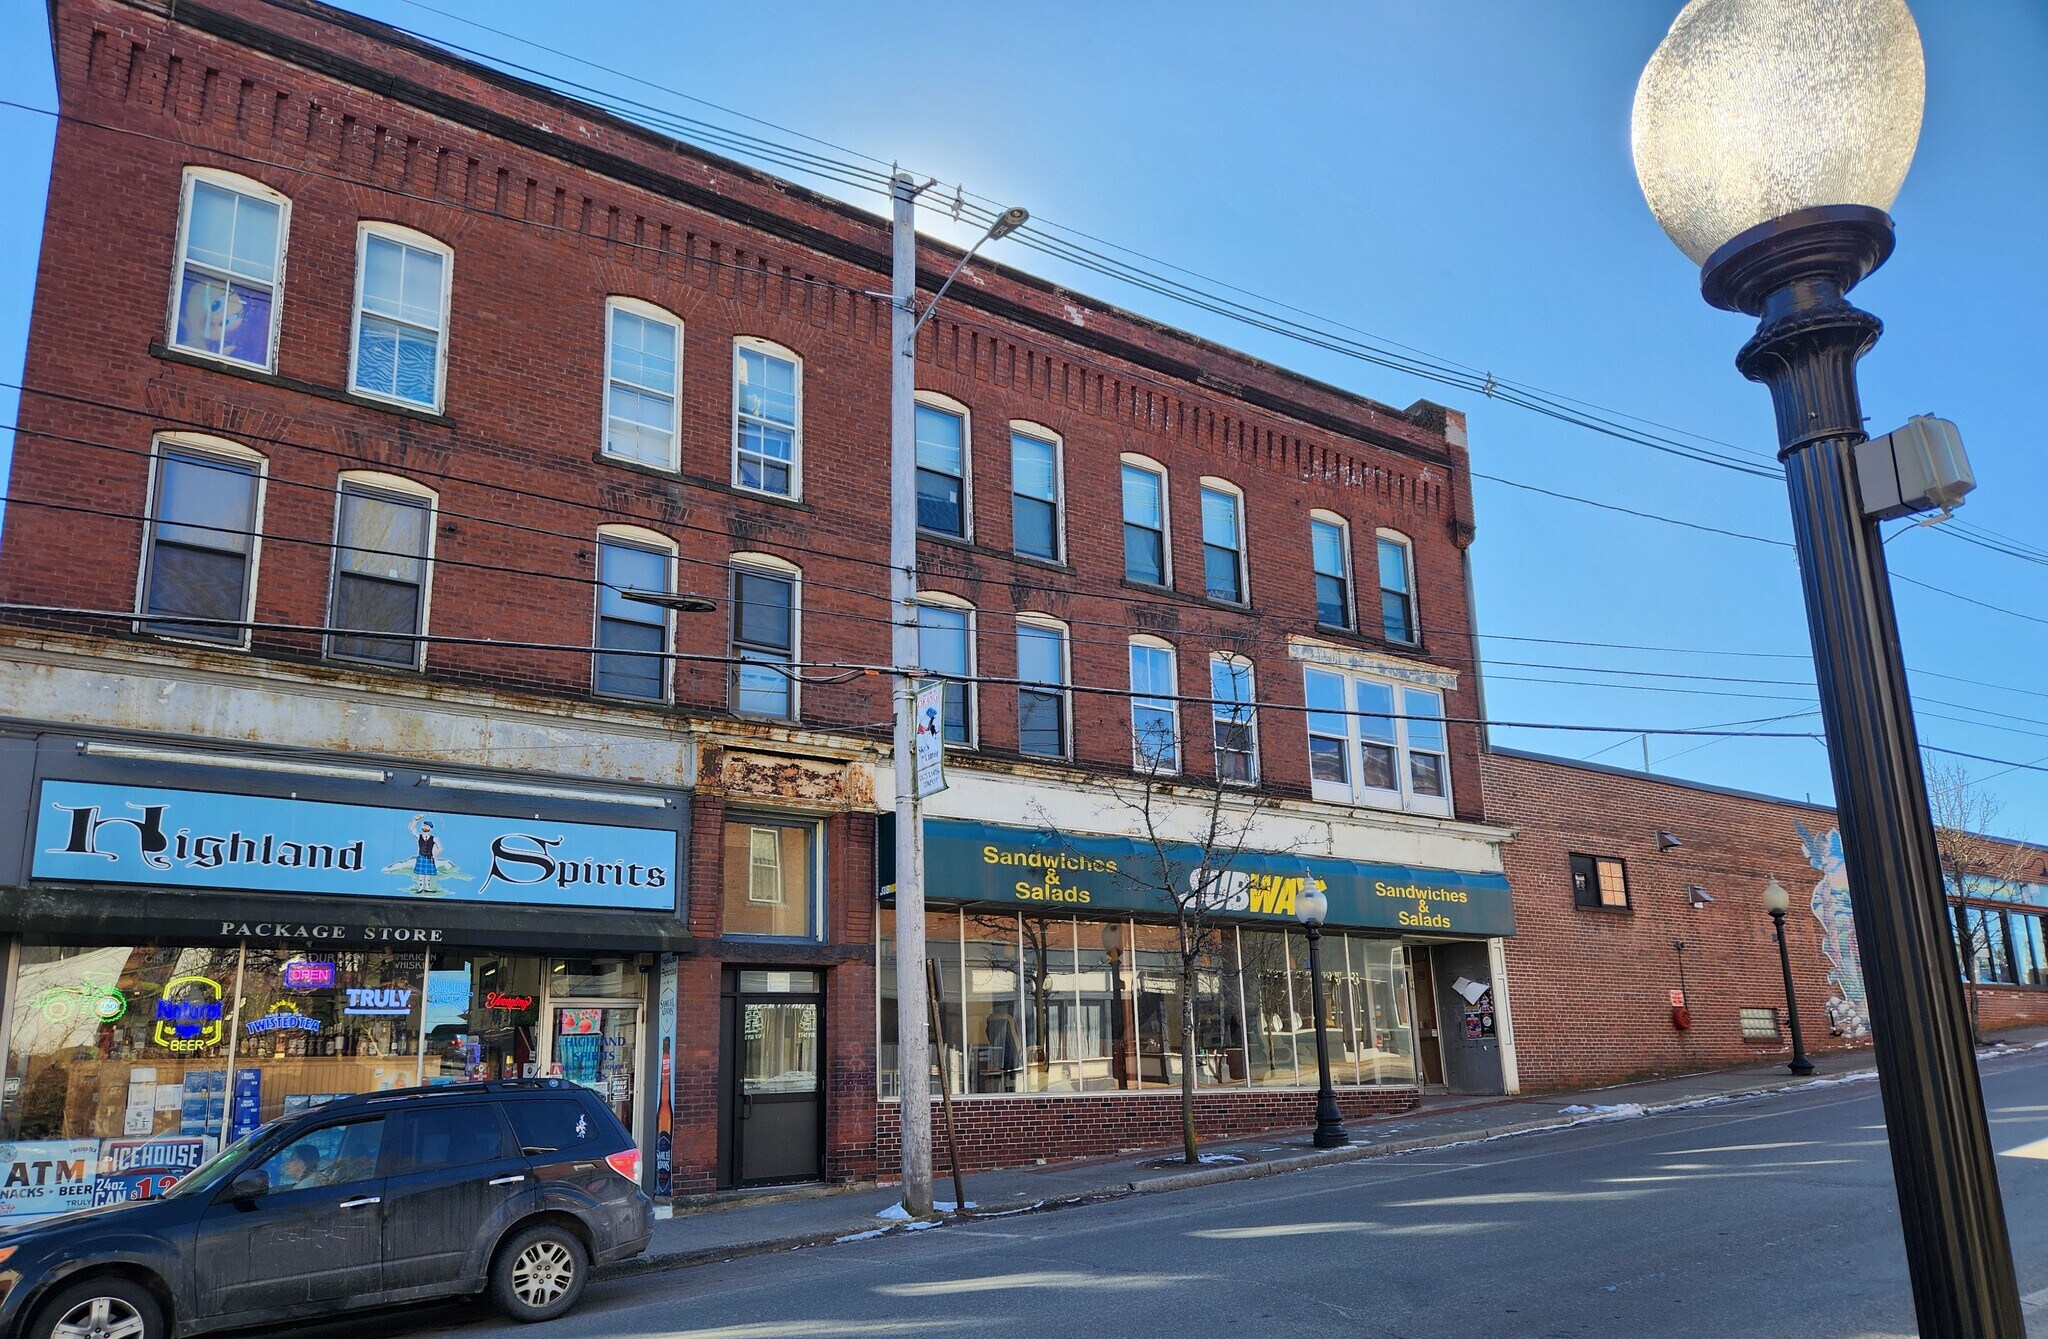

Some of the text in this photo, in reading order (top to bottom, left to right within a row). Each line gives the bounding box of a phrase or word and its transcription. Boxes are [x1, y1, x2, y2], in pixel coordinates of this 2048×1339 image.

[45, 801, 366, 872] Highland
[477, 832, 669, 895] Spirits
[983, 846, 1118, 873] Sandwiches
[1045, 868, 1061, 885] &
[1015, 881, 1091, 903] Salads
[1375, 881, 1468, 904] Sandwiches
[1418, 899, 1430, 914] &
[1398, 910, 1451, 929] Salads
[220, 921, 443, 943] PACKAGE STORE
[394, 953, 437, 962] MERICN
[290, 968, 330, 981] OPEN
[246, 1016, 321, 1034] TWISTED TEA
[170, 1039, 205, 1051] BEER
[573, 1050, 615, 1062] SPIRTS
[113, 1143, 200, 1171] ICEHOUSE
[4, 1159, 86, 1188] ATM
[0, 1185, 93, 1200] NACKS BEER
[96, 1178, 128, 1192] 24oz.
[66, 1199, 92, 1207] TRULY
[94, 1190, 127, 1207] CAN
